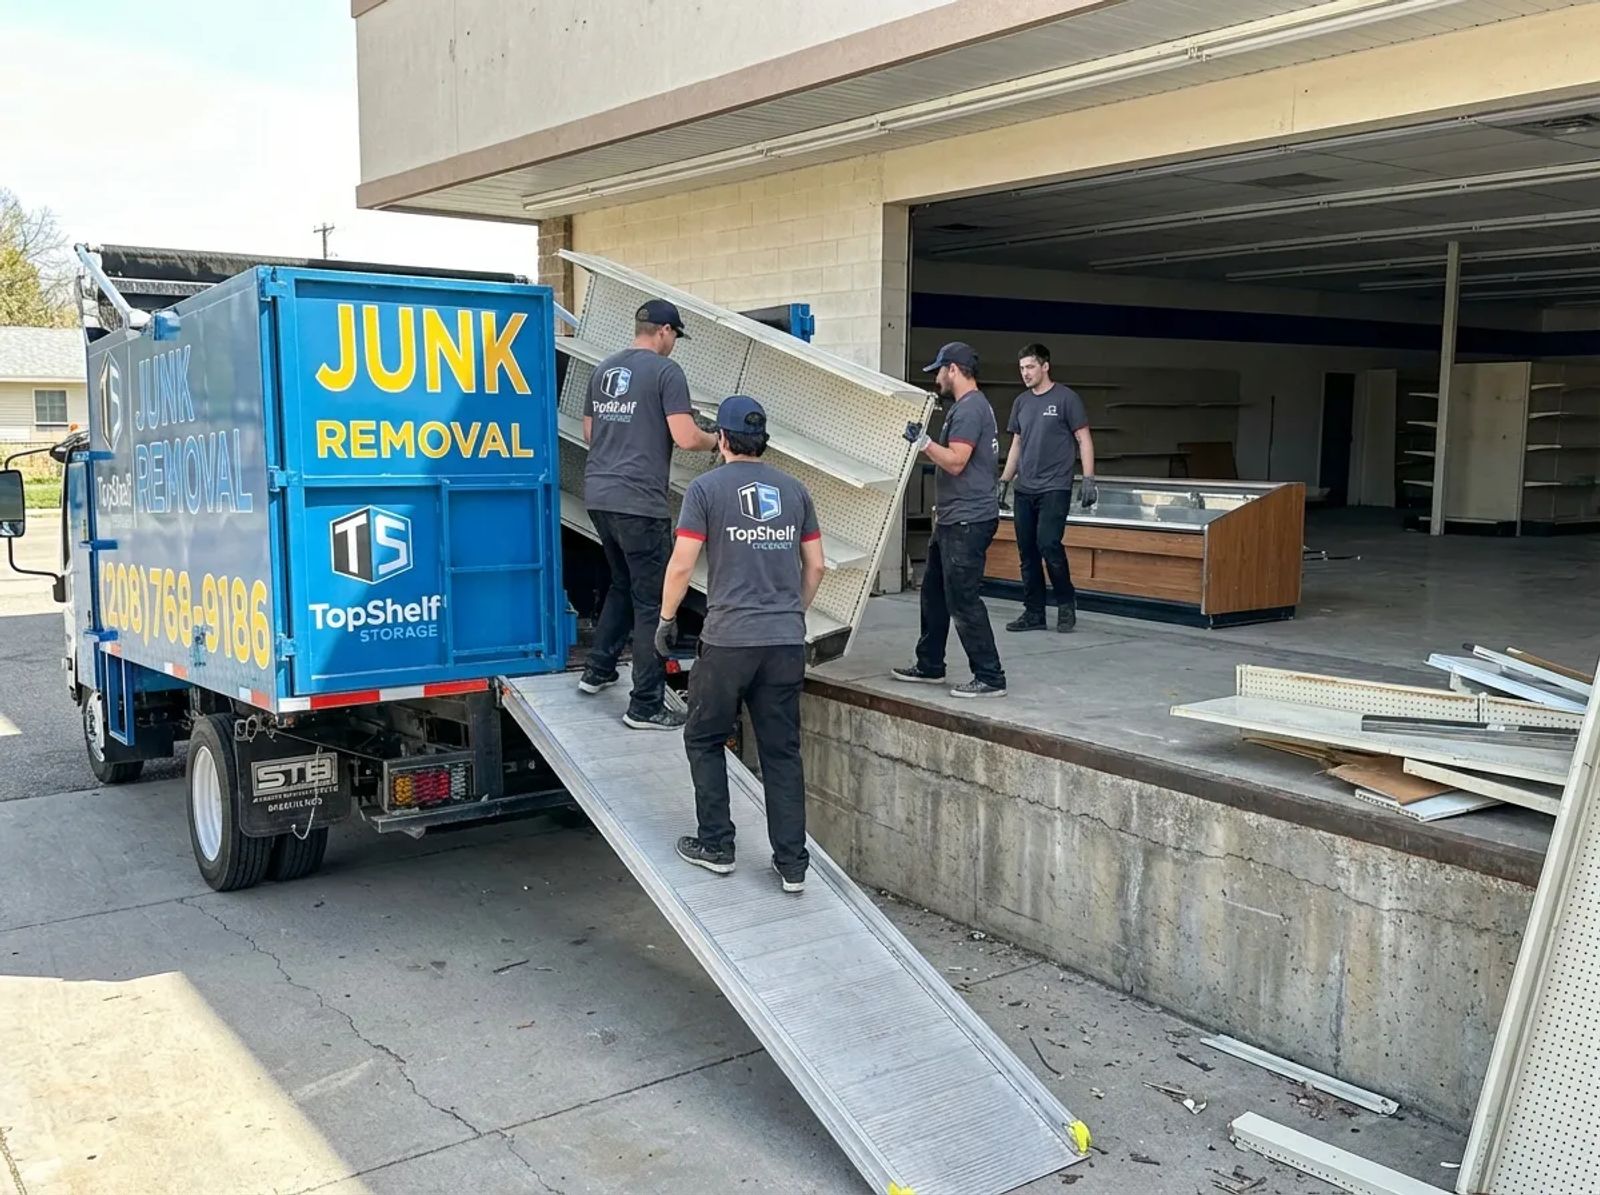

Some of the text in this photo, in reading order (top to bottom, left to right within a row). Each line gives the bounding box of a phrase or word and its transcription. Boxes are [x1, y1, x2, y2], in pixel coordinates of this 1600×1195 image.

[315, 303, 532, 395] JUNK
[135, 344, 195, 431] JUNK
[316, 420, 534, 459] REMOVAL
[135, 428, 253, 515] REMOVAL
[741, 487, 779, 517] TS
[334, 511, 408, 575] TS
[726, 525, 796, 544] TopShelf
[99, 560, 270, 670] (208)768-9186
[308, 594, 441, 632] TopShelf
[360, 624, 438, 642] STORAGE
